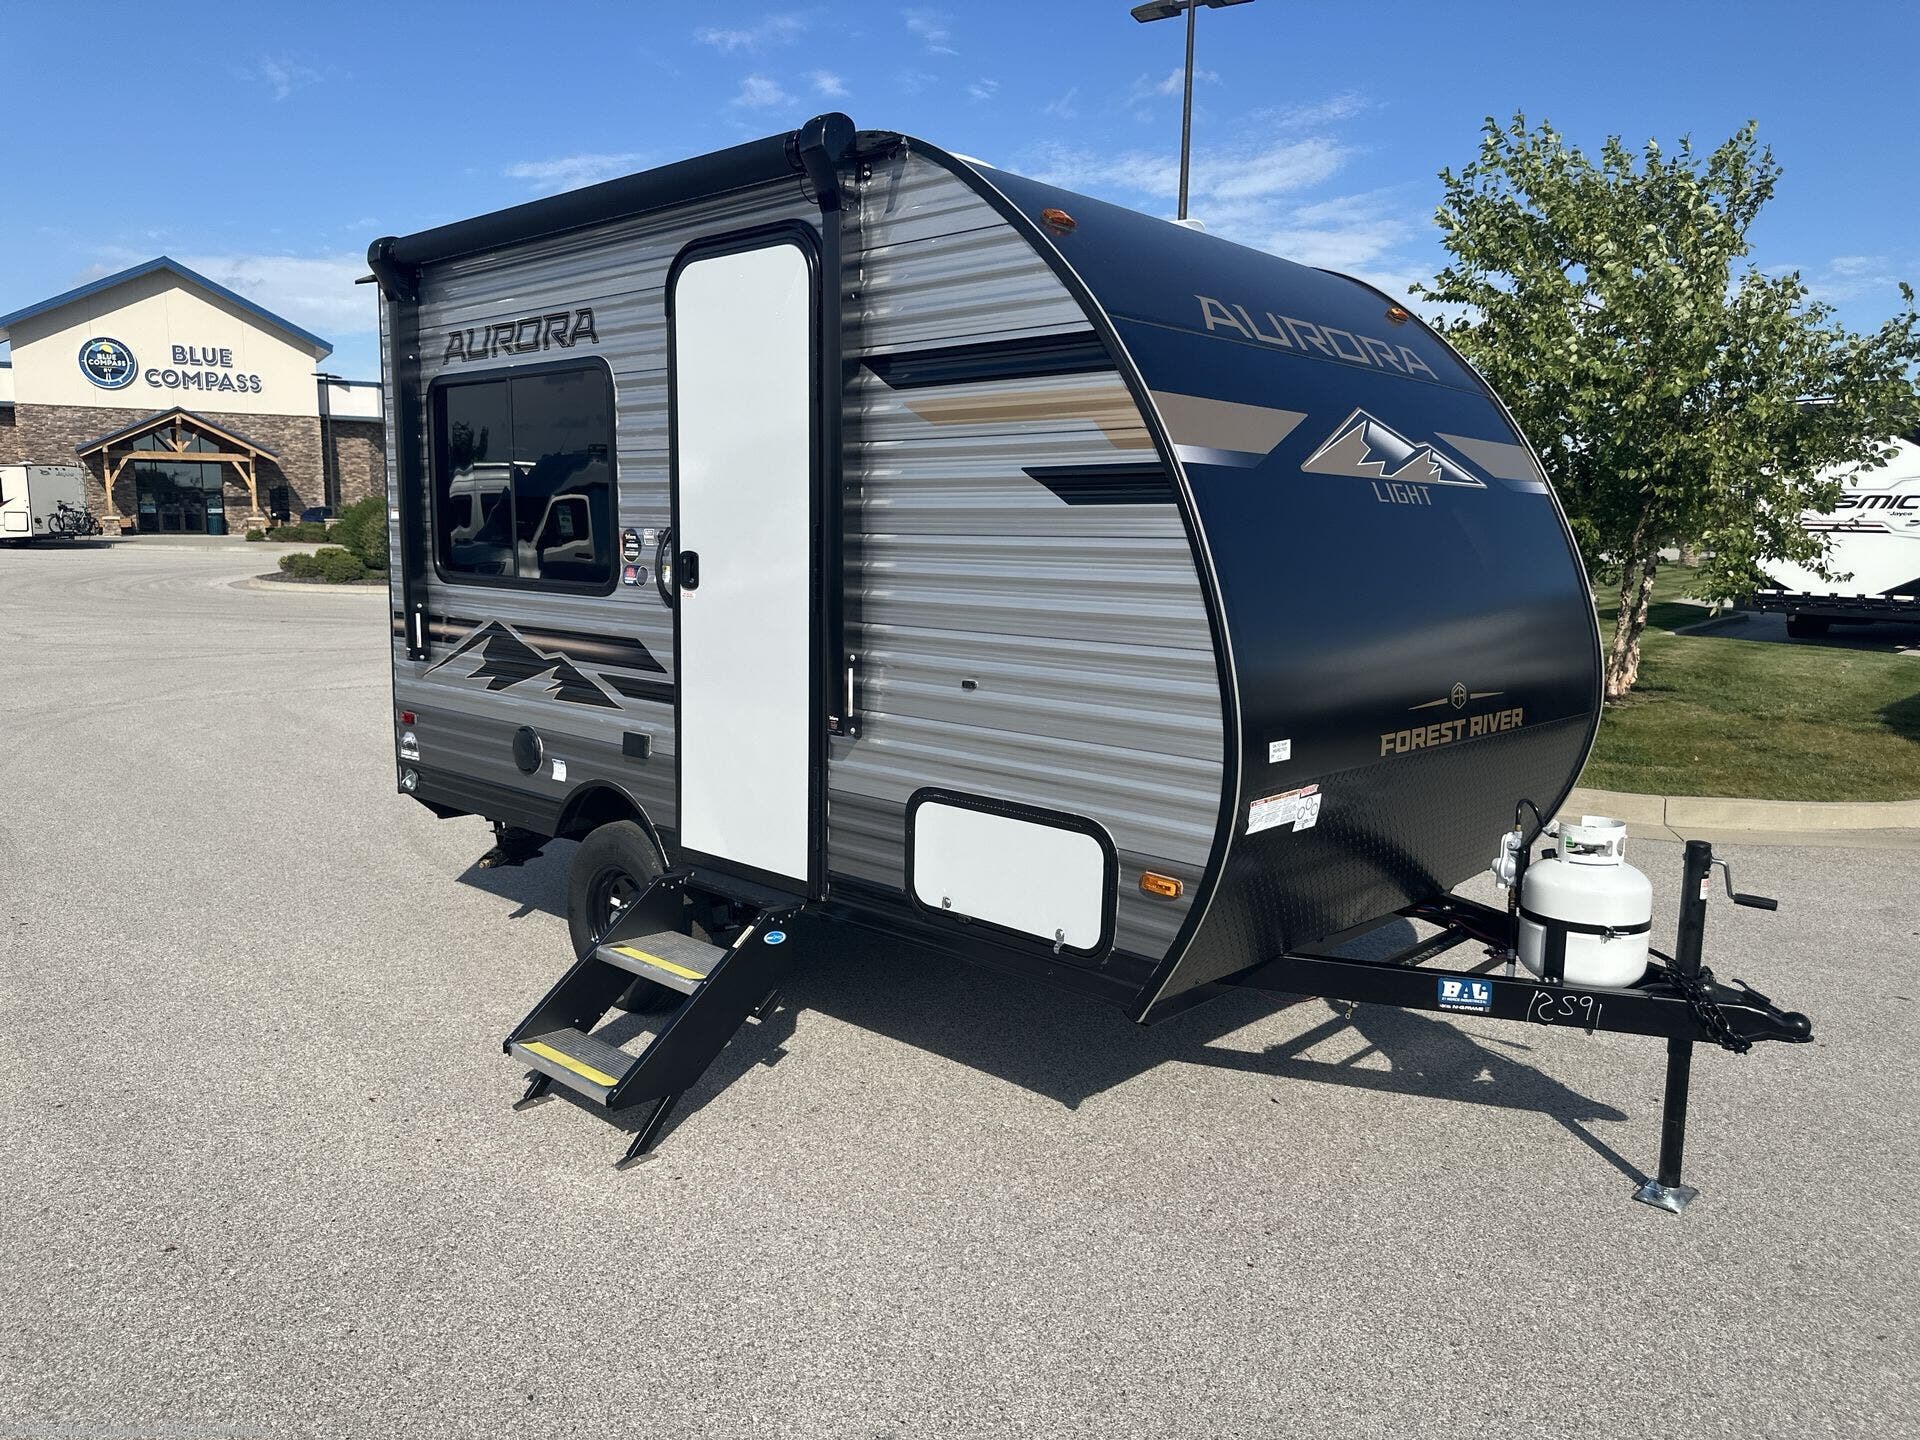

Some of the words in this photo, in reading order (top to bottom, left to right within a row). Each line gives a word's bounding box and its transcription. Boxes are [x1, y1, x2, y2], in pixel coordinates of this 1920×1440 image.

[442, 307, 599, 366] AURORA
[1194, 294, 1439, 380] AURORA
[171, 345, 233, 368] BLUE
[144, 368, 262, 394] COMPASS
[1371, 481, 1431, 505] LIGHT
[1380, 718, 1466, 757] FOREST
[1469, 707, 1523, 737] RIVER
